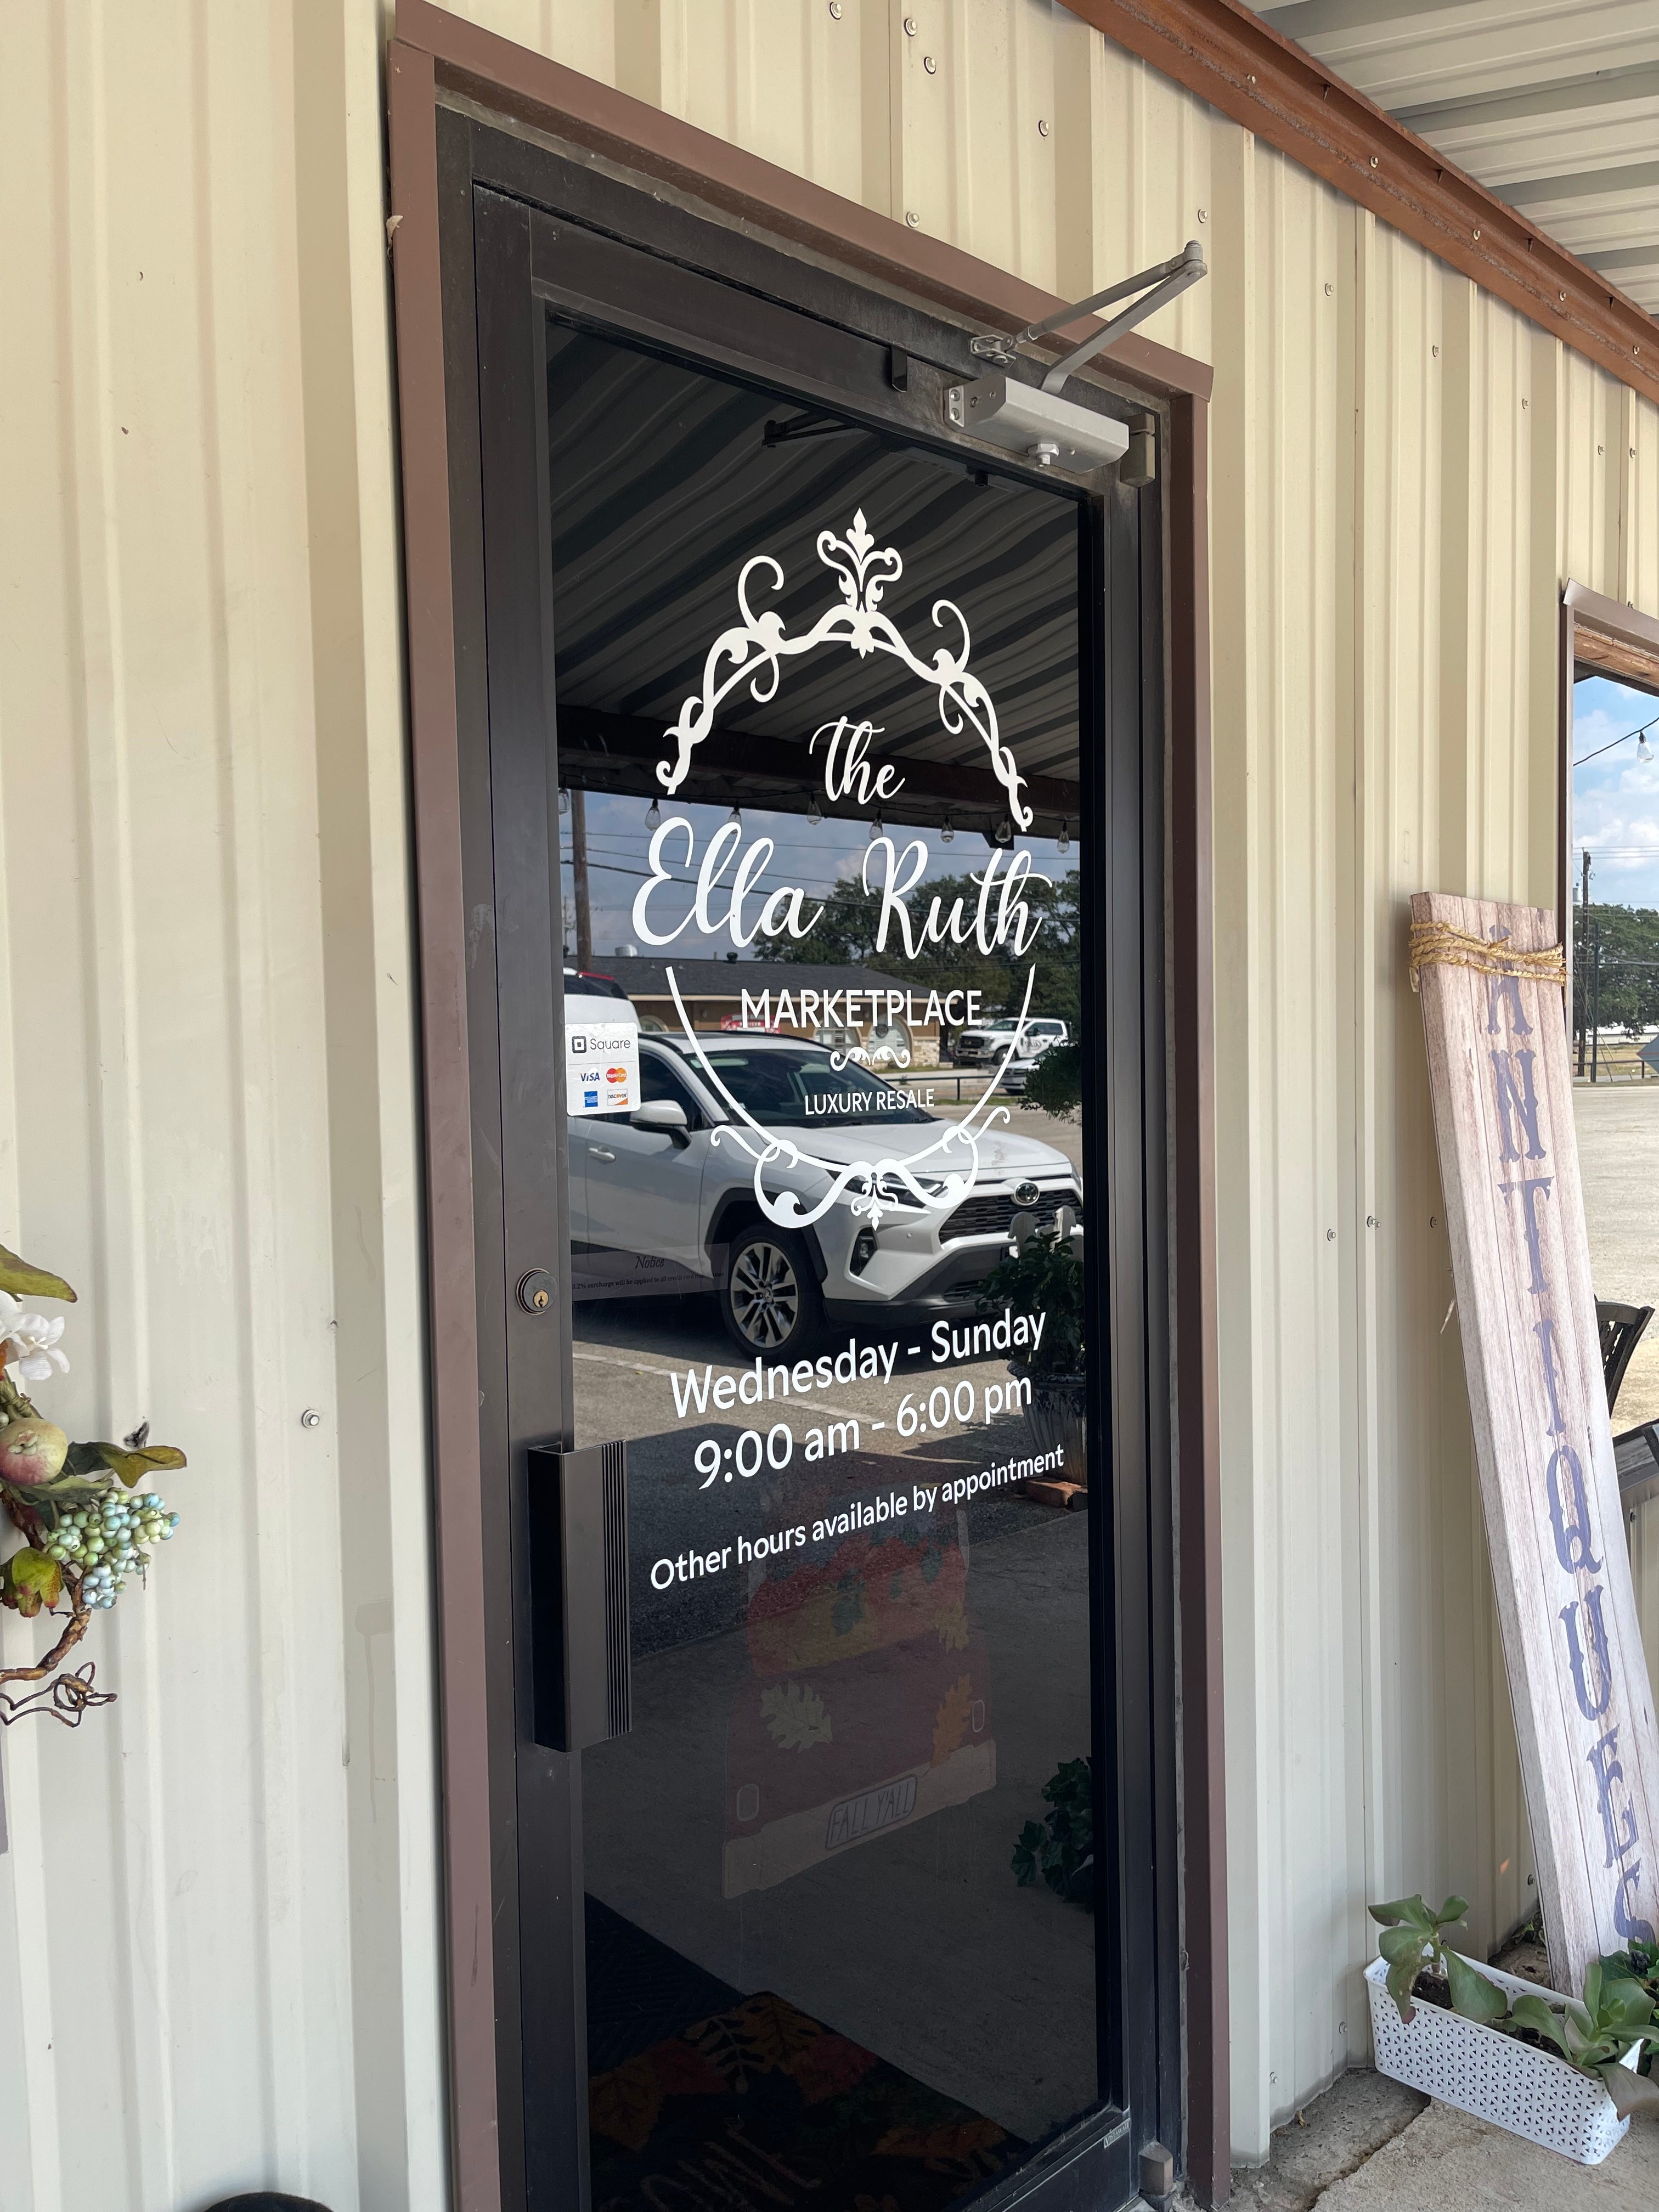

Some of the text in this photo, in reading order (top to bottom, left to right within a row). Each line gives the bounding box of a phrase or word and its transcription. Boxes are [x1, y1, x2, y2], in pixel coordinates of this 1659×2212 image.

[632, 817, 1053, 960] Ella Ruth
[741, 989, 983, 1028] MARKETPLACE
[590, 1038, 631, 1053] Square
[579, 1072, 600, 1082] VISA
[804, 1088, 935, 1115] LUXURY RESALE
[633, 1277, 653, 1285] applied
[634, 1255, 665, 1269] Notice
[670, 1308, 1046, 1418] Wednesday - Sunday
[694, 1377, 1031, 1490] 9:00 am - 6:00 pm
[1486, 924, 1657, 1945] ANTIQUES
[651, 1444, 1064, 1589] Other hours available by appointment
[830, 1782, 910, 1844] FALL Y'ALL
